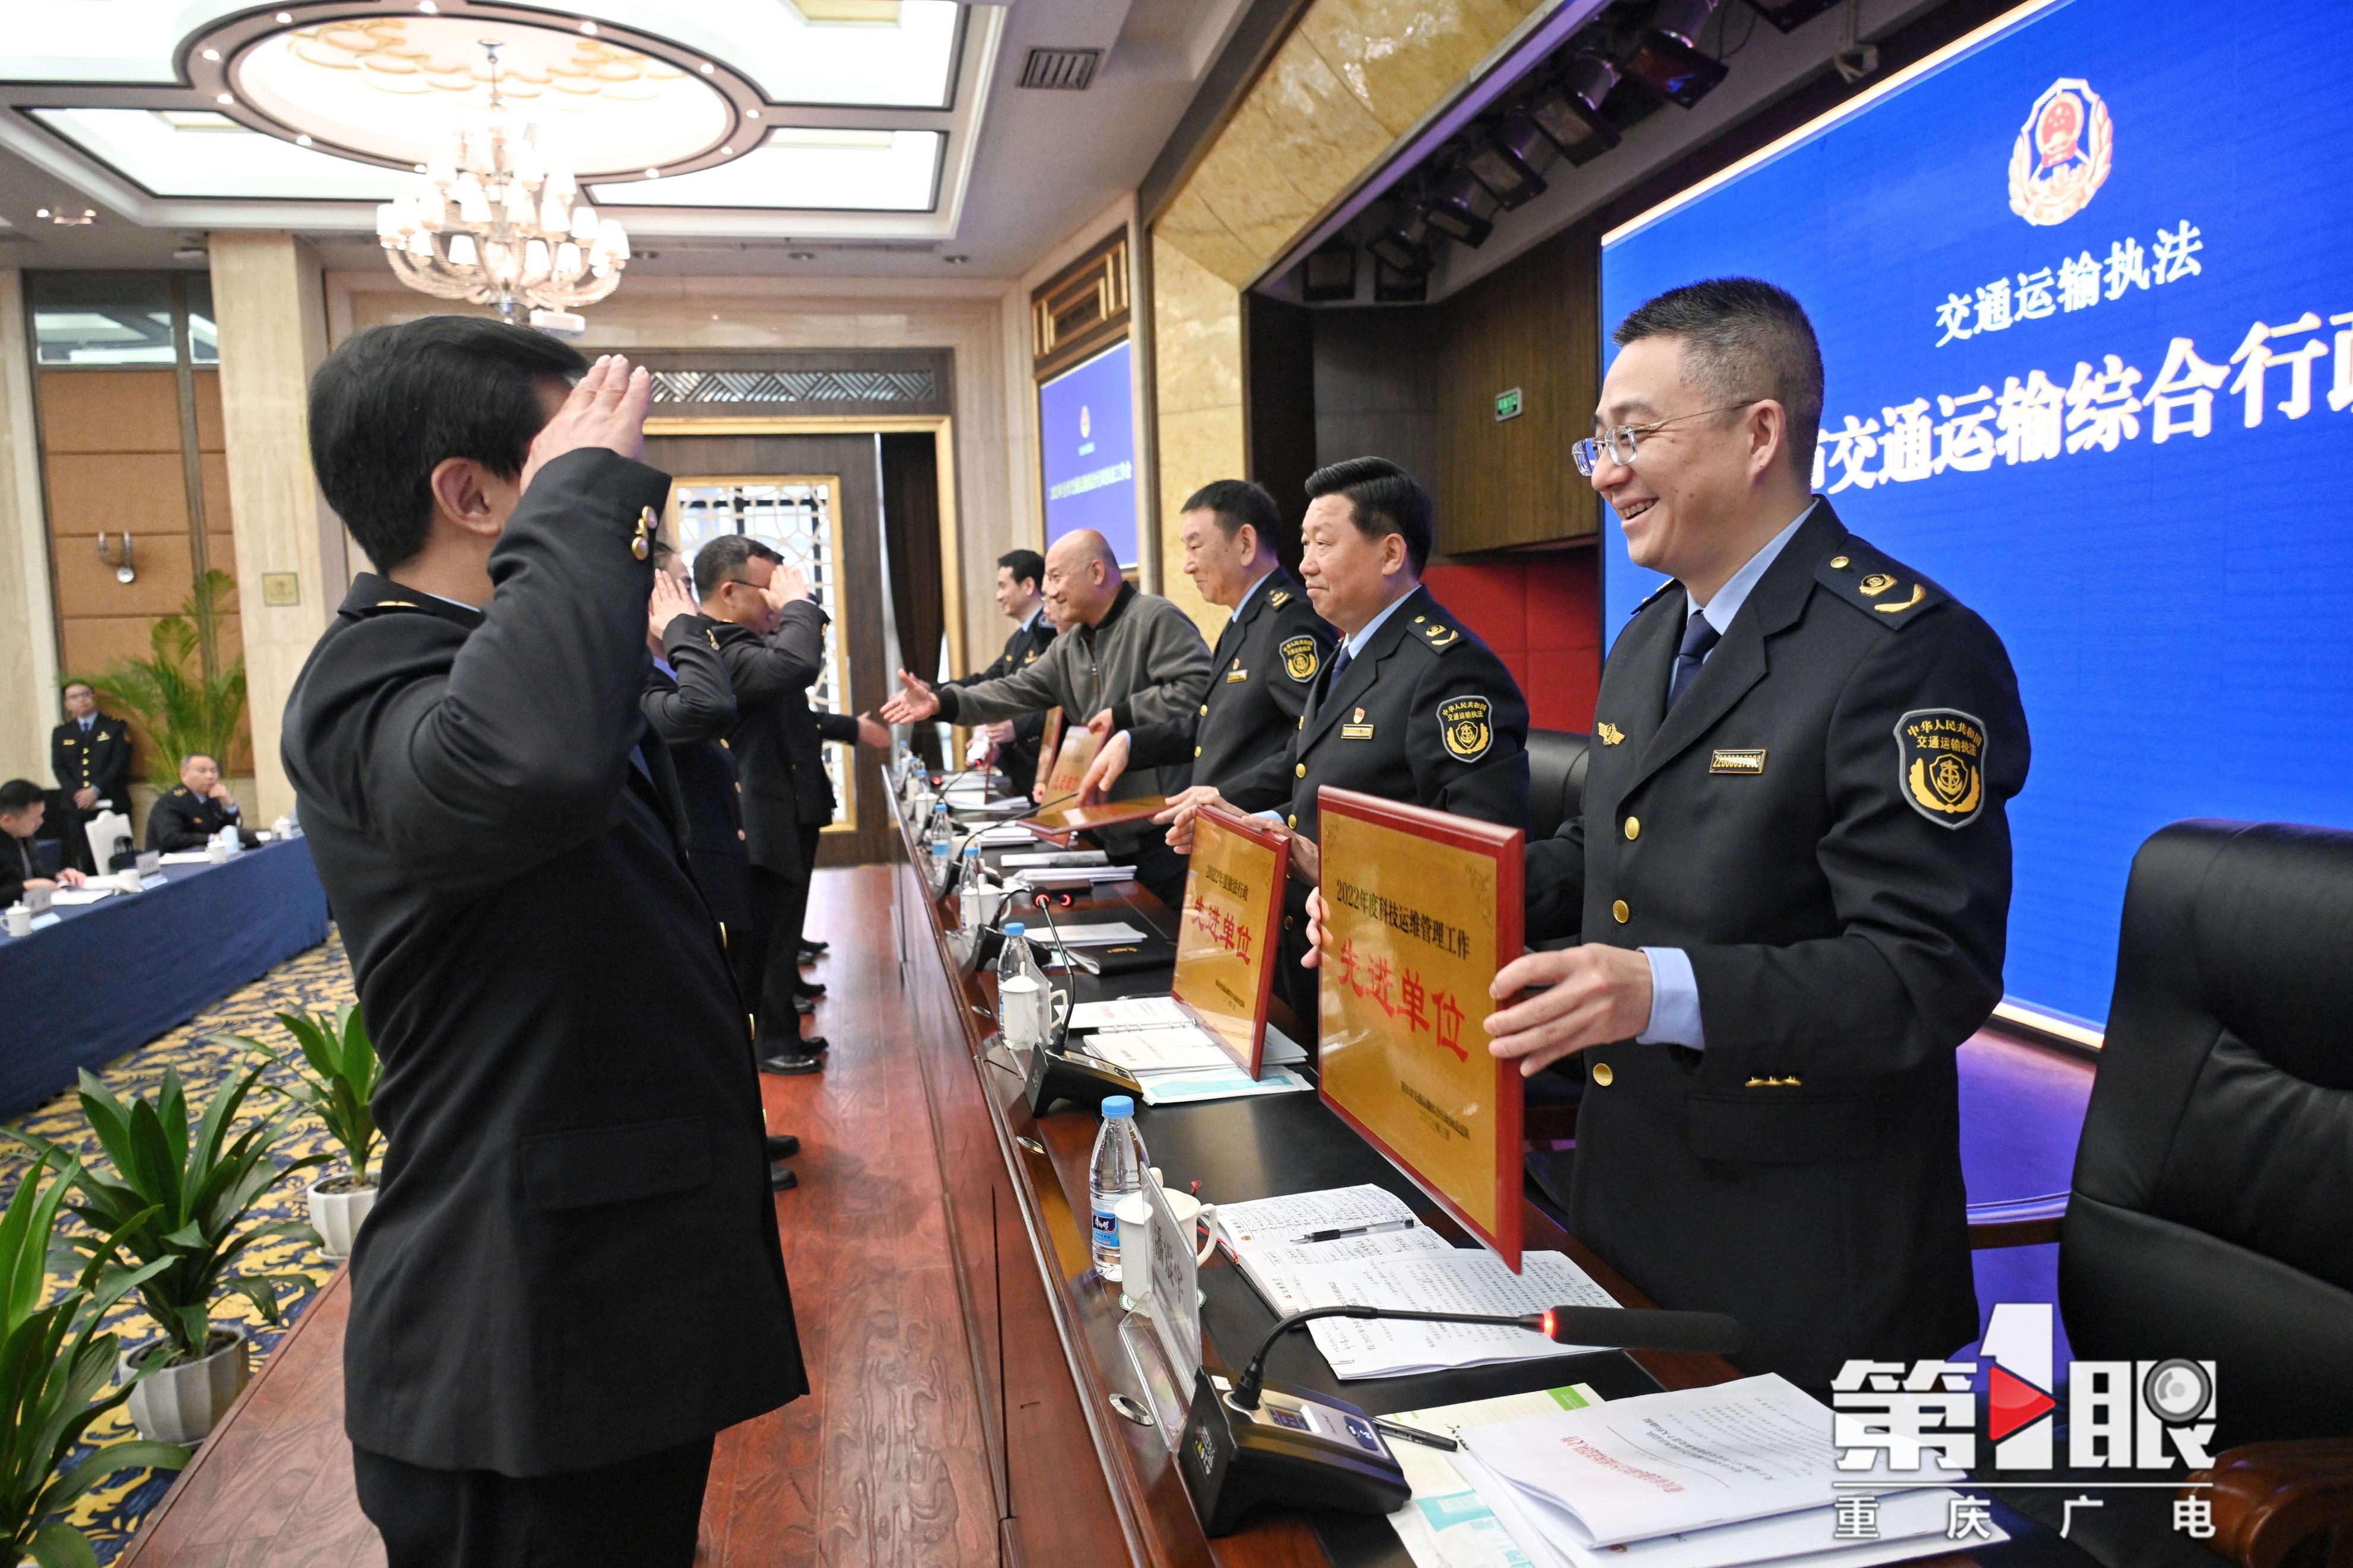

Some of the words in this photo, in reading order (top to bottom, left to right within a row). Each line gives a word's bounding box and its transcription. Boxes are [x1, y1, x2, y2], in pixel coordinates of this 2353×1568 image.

[1935, 220, 2205, 348] 交通运输执法
[1448, 711, 1484, 721] 交通运输执法
[1907, 720, 1983, 747] 中华人民共和国
[1916, 736, 1977, 756] 交通运输执法
[1191, 895, 1252, 966] 先进单位
[1337, 879, 1470, 960] 2022年度科技运维管理工作
[1338, 936, 1468, 1063] 先进单位
